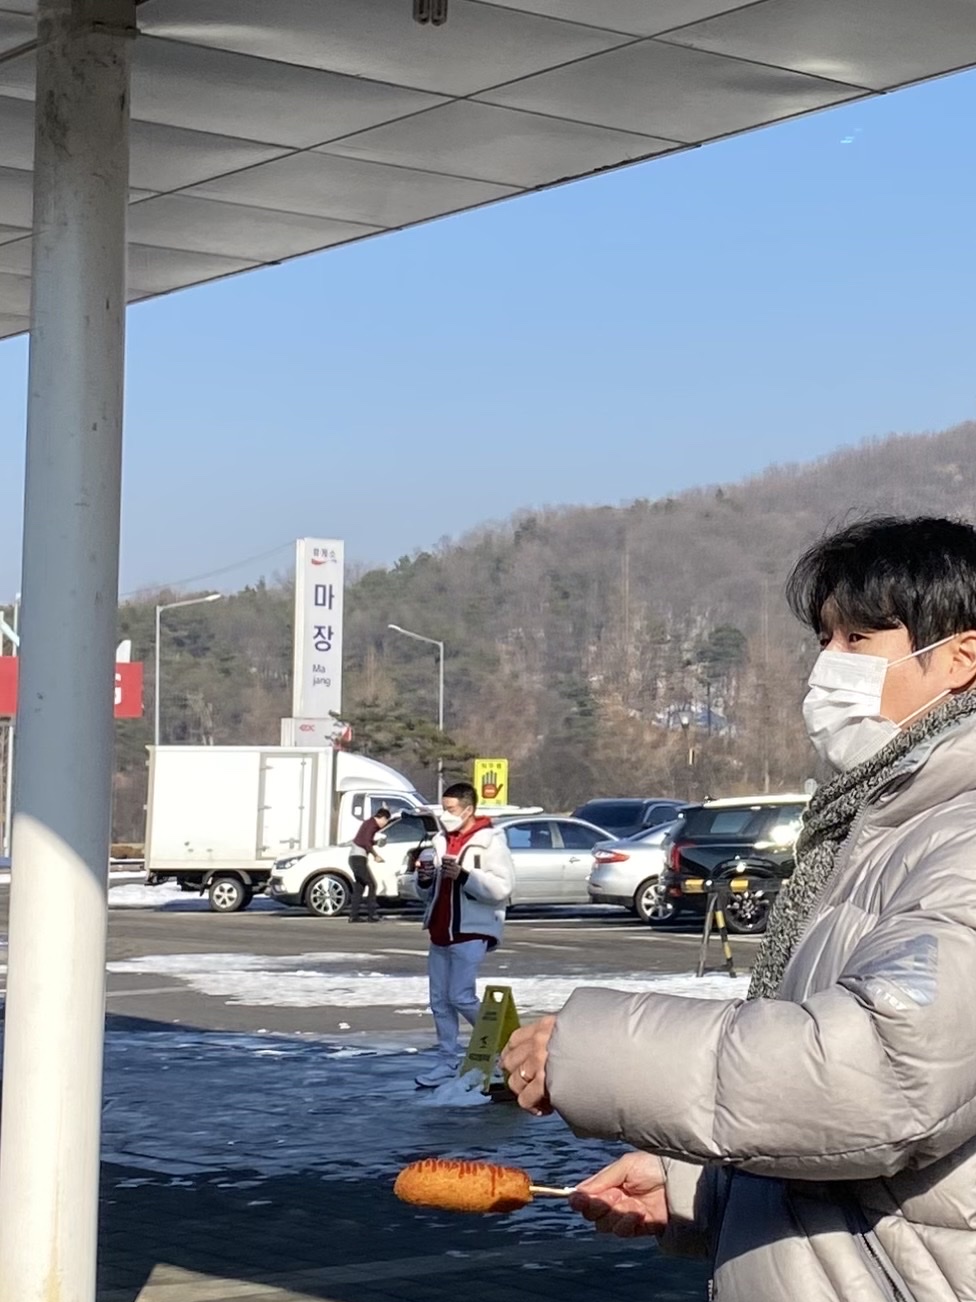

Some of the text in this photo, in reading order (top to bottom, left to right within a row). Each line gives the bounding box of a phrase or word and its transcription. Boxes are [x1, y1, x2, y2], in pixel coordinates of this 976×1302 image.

[313, 584, 335, 652] 마장
[312, 664, 326, 673] Ma
[312, 675, 331, 688] jang
